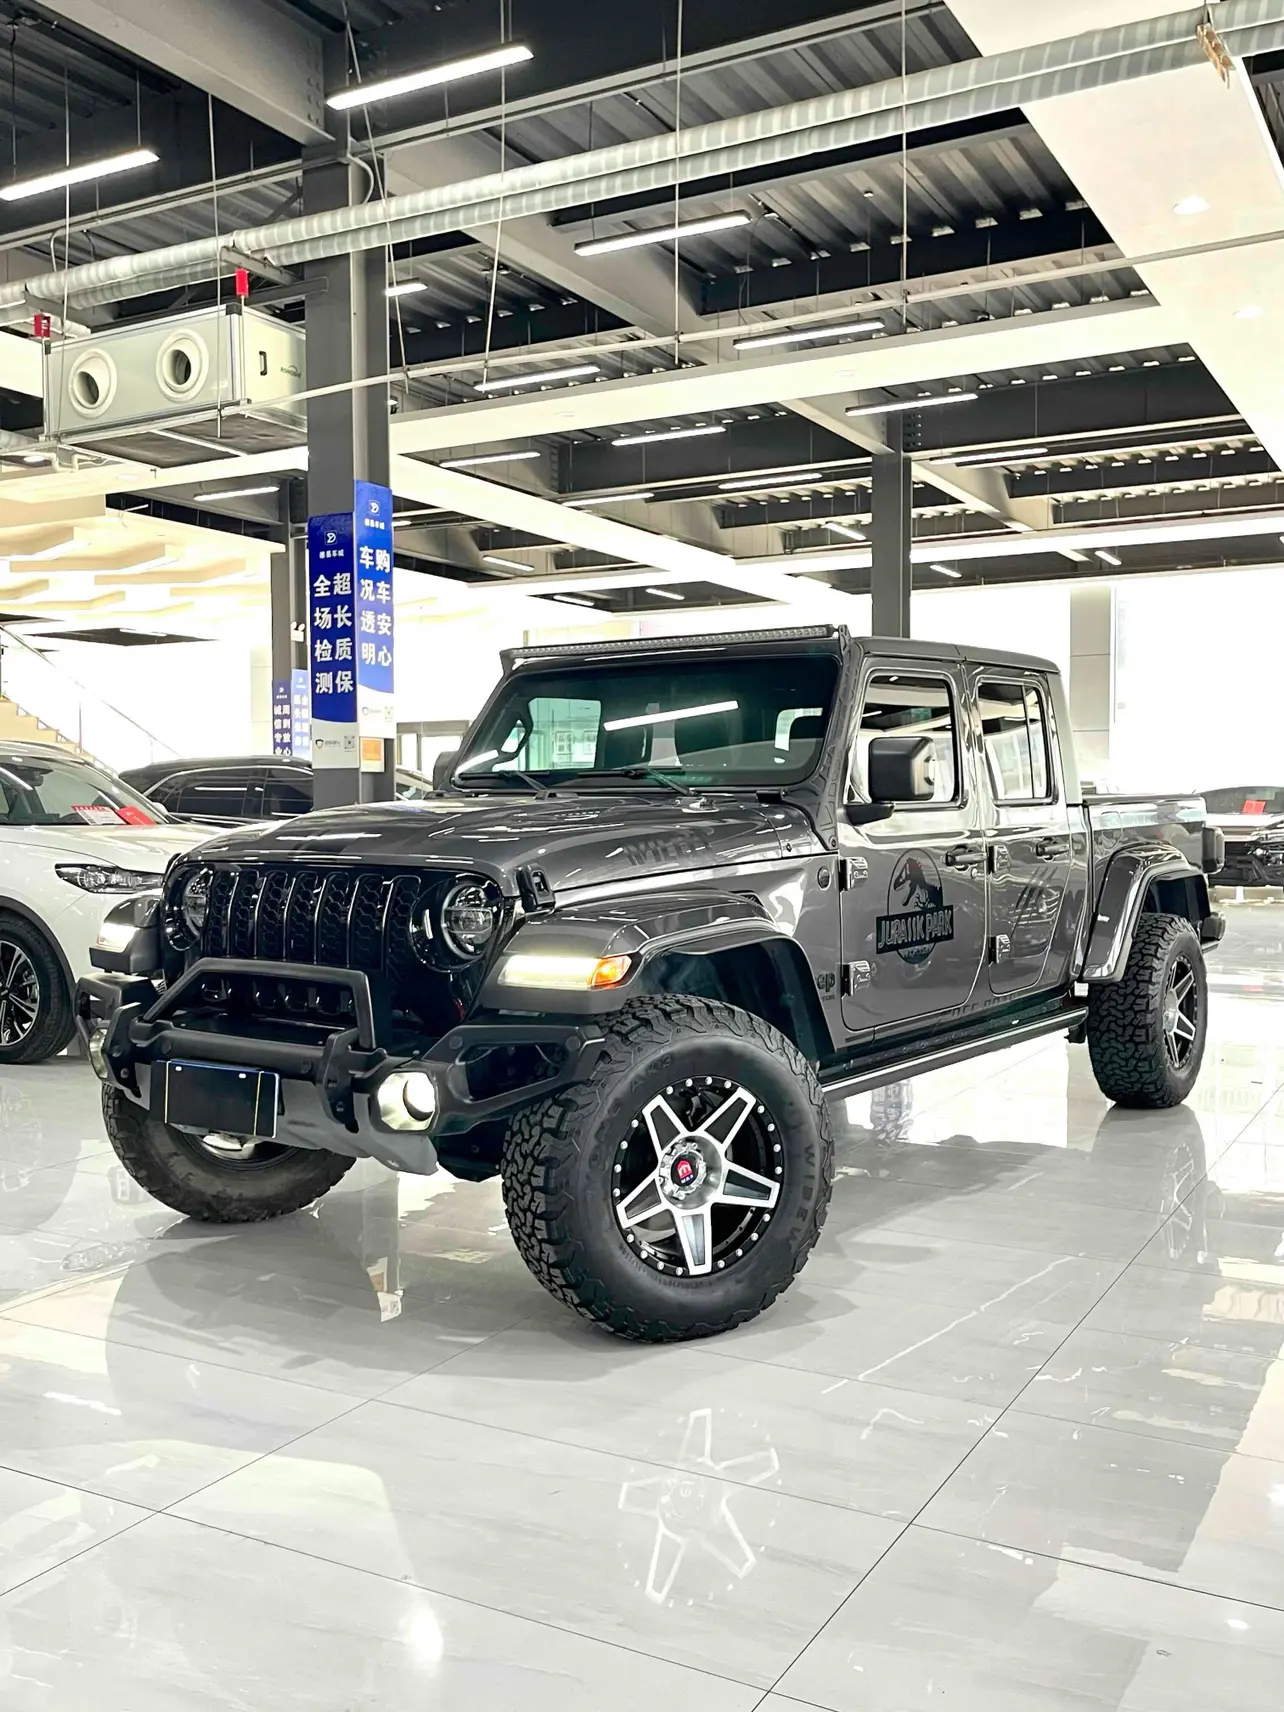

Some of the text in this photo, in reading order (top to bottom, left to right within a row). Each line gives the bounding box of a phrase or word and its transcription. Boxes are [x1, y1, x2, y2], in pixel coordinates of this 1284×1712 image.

[313, 574, 333, 694] 全场检测
[333, 572, 354, 694] 超长质保
[359, 545, 376, 665] 车况透明
[375, 549, 392, 667] 购车安心
[926, 909, 953, 941] PARK
